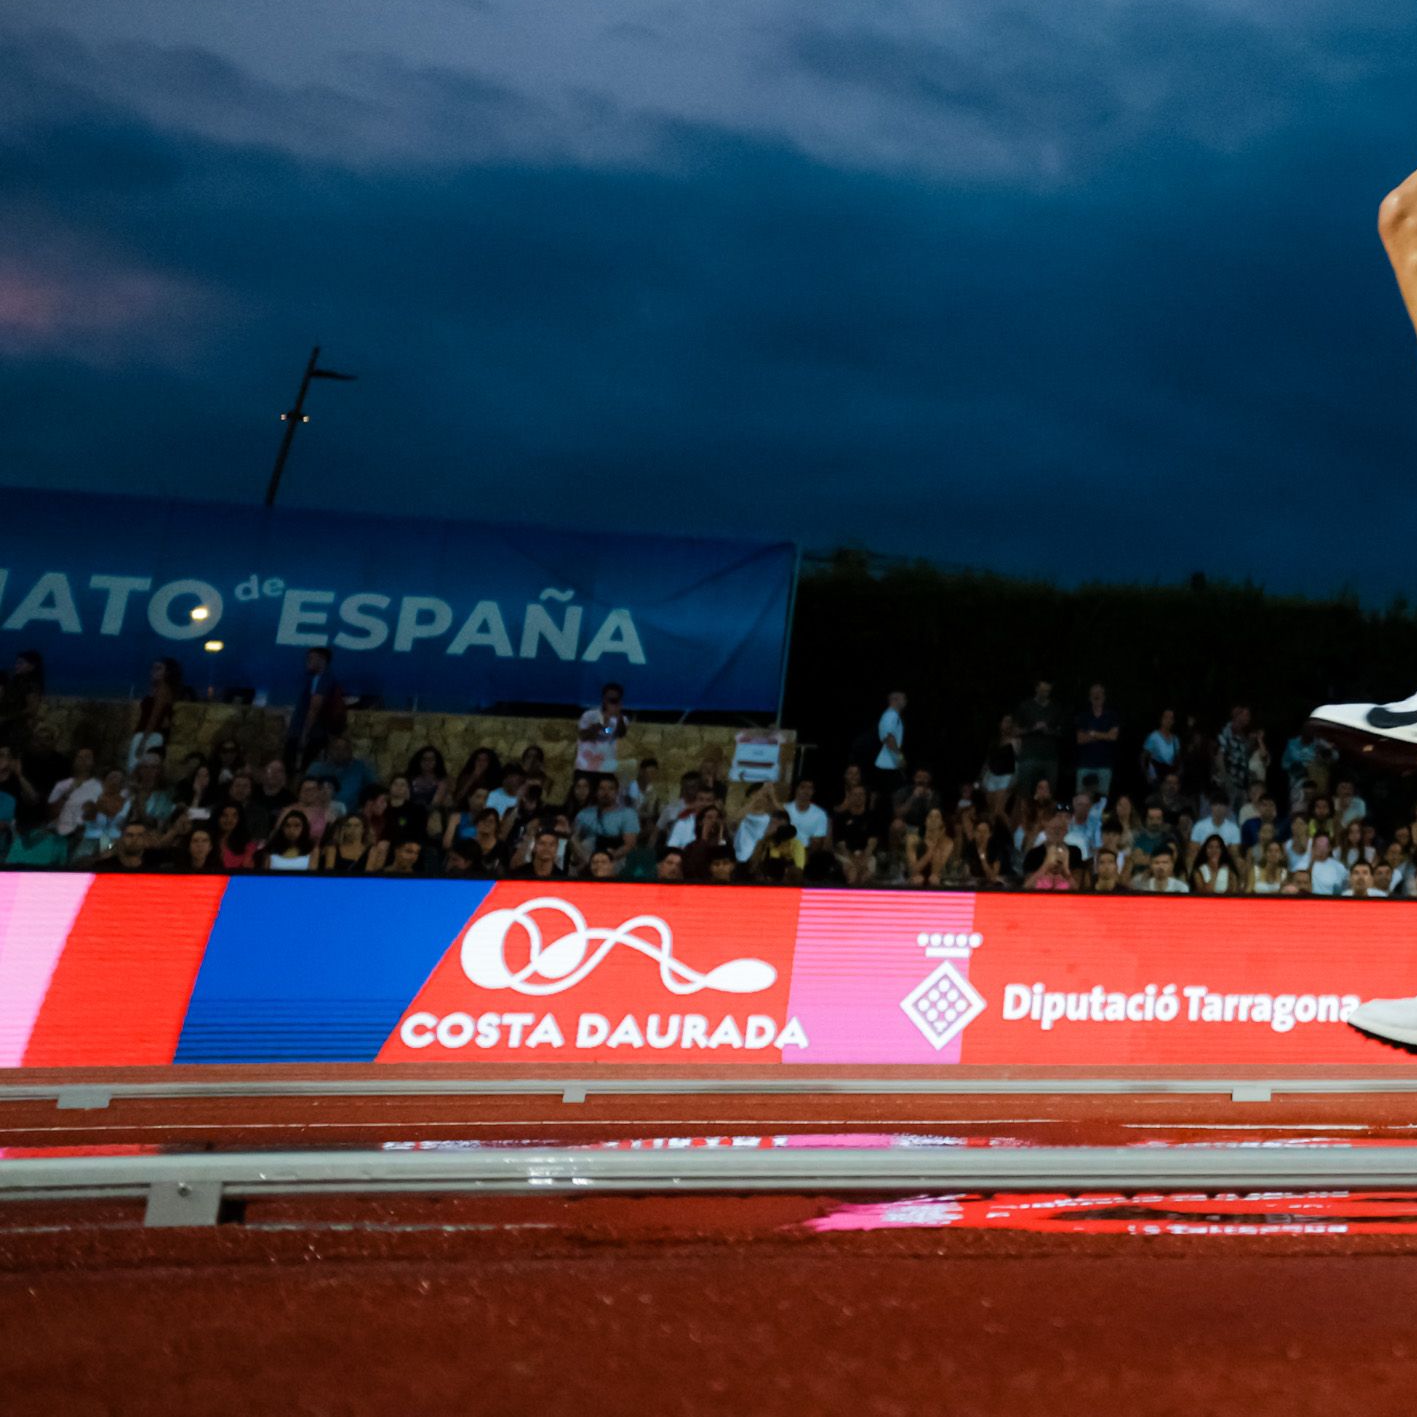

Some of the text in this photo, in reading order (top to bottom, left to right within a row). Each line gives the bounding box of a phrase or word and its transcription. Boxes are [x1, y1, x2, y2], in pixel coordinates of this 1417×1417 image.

[0, 568, 646, 665] ATO de ESPAÑA
[400, 1012, 808, 1050] COSTA DAURADA
[1002, 983, 1358, 1032] Diputació Tarragona
